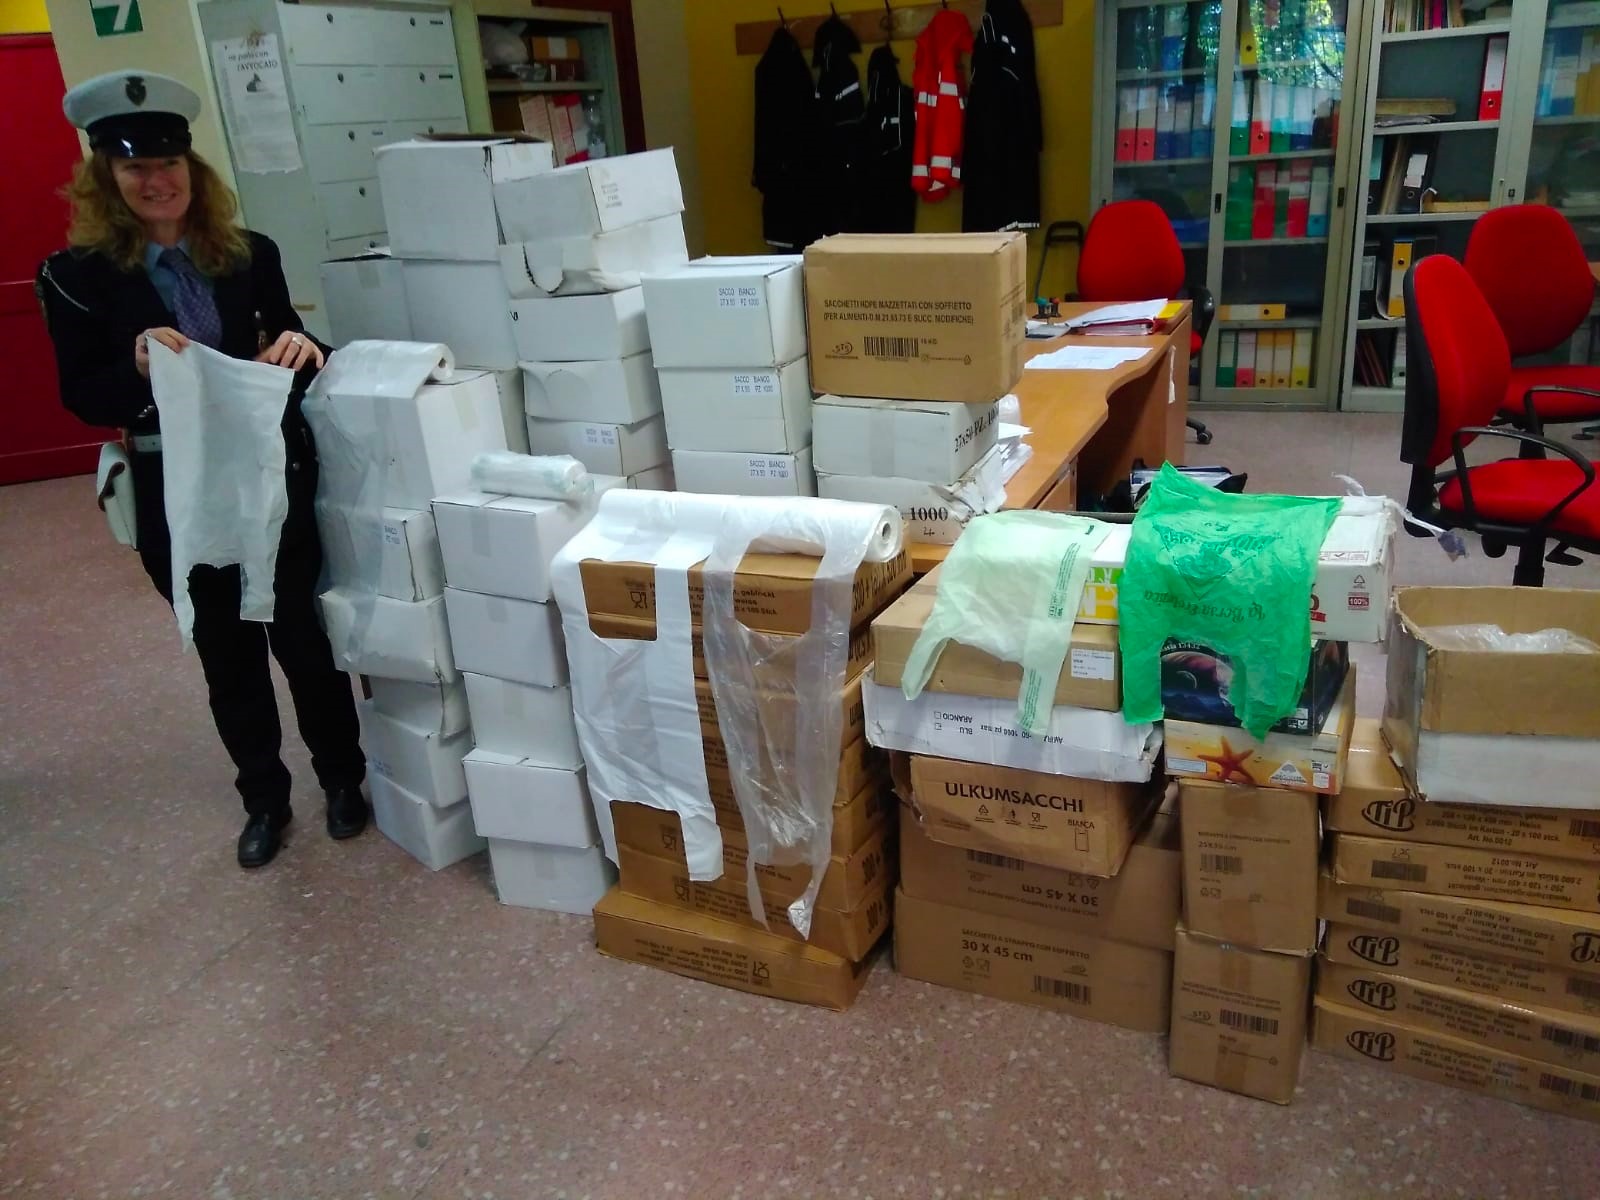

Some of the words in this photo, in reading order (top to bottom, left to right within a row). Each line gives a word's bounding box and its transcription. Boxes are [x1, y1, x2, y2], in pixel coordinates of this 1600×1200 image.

[934, 301, 972, 310] SOFFIETTO
[909, 506, 949, 521] 1000
[942, 712, 973, 724] ARANCIO
[945, 782, 1083, 813] ULKUMSACCHI
[1021, 883, 1042, 895] cm
[1046, 888, 1063, 900] 45
[1081, 895, 1099, 907] 30
[962, 939, 978, 951] 30
[993, 946, 1009, 958] 45
[1013, 952, 1033, 962] cm
